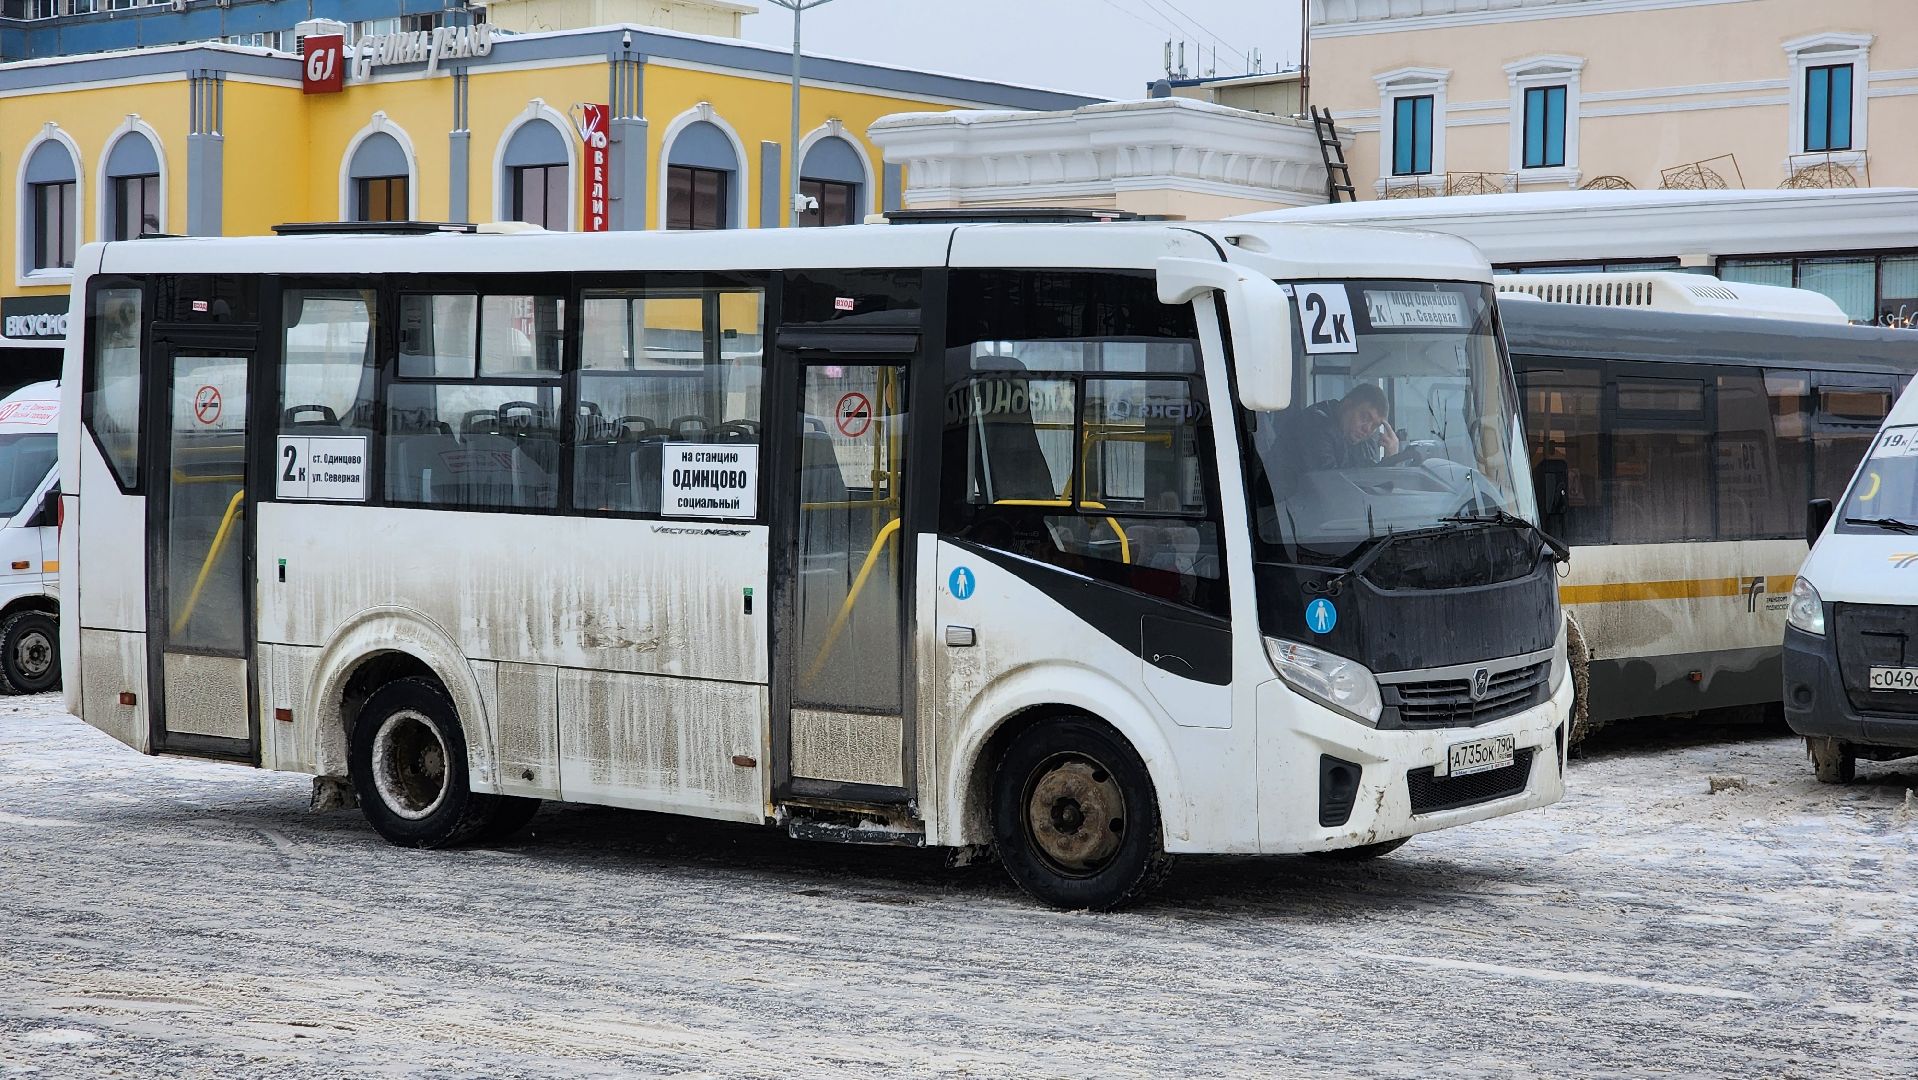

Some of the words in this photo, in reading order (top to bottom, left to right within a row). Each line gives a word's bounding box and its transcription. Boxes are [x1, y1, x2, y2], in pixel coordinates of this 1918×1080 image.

[352, 34, 428, 81] GLORIA
[424, 23, 493, 79] JEANS
[307, 48, 335, 81] GJ
[591, 130, 607, 230] ЮВЕЛИР
[836, 299, 852, 308] ВХОД
[1391, 292, 1414, 307] МЦД
[1414, 292, 1457, 307] Одинцово
[1400, 312, 1415, 324] ул.
[1416, 309, 1457, 324] Северная
[313, 454, 323, 464] ст.
[324, 453, 361, 465] Одинцово
[682, 452, 693, 462] на
[695, 452, 738, 464] станцию
[312, 473, 322, 483] ул.
[324, 472, 360, 483] Северная
[672, 469, 747, 491] ОДИНЦОВО
[677, 496, 740, 510] социальный
[1453, 744, 1495, 767] А735ОК
